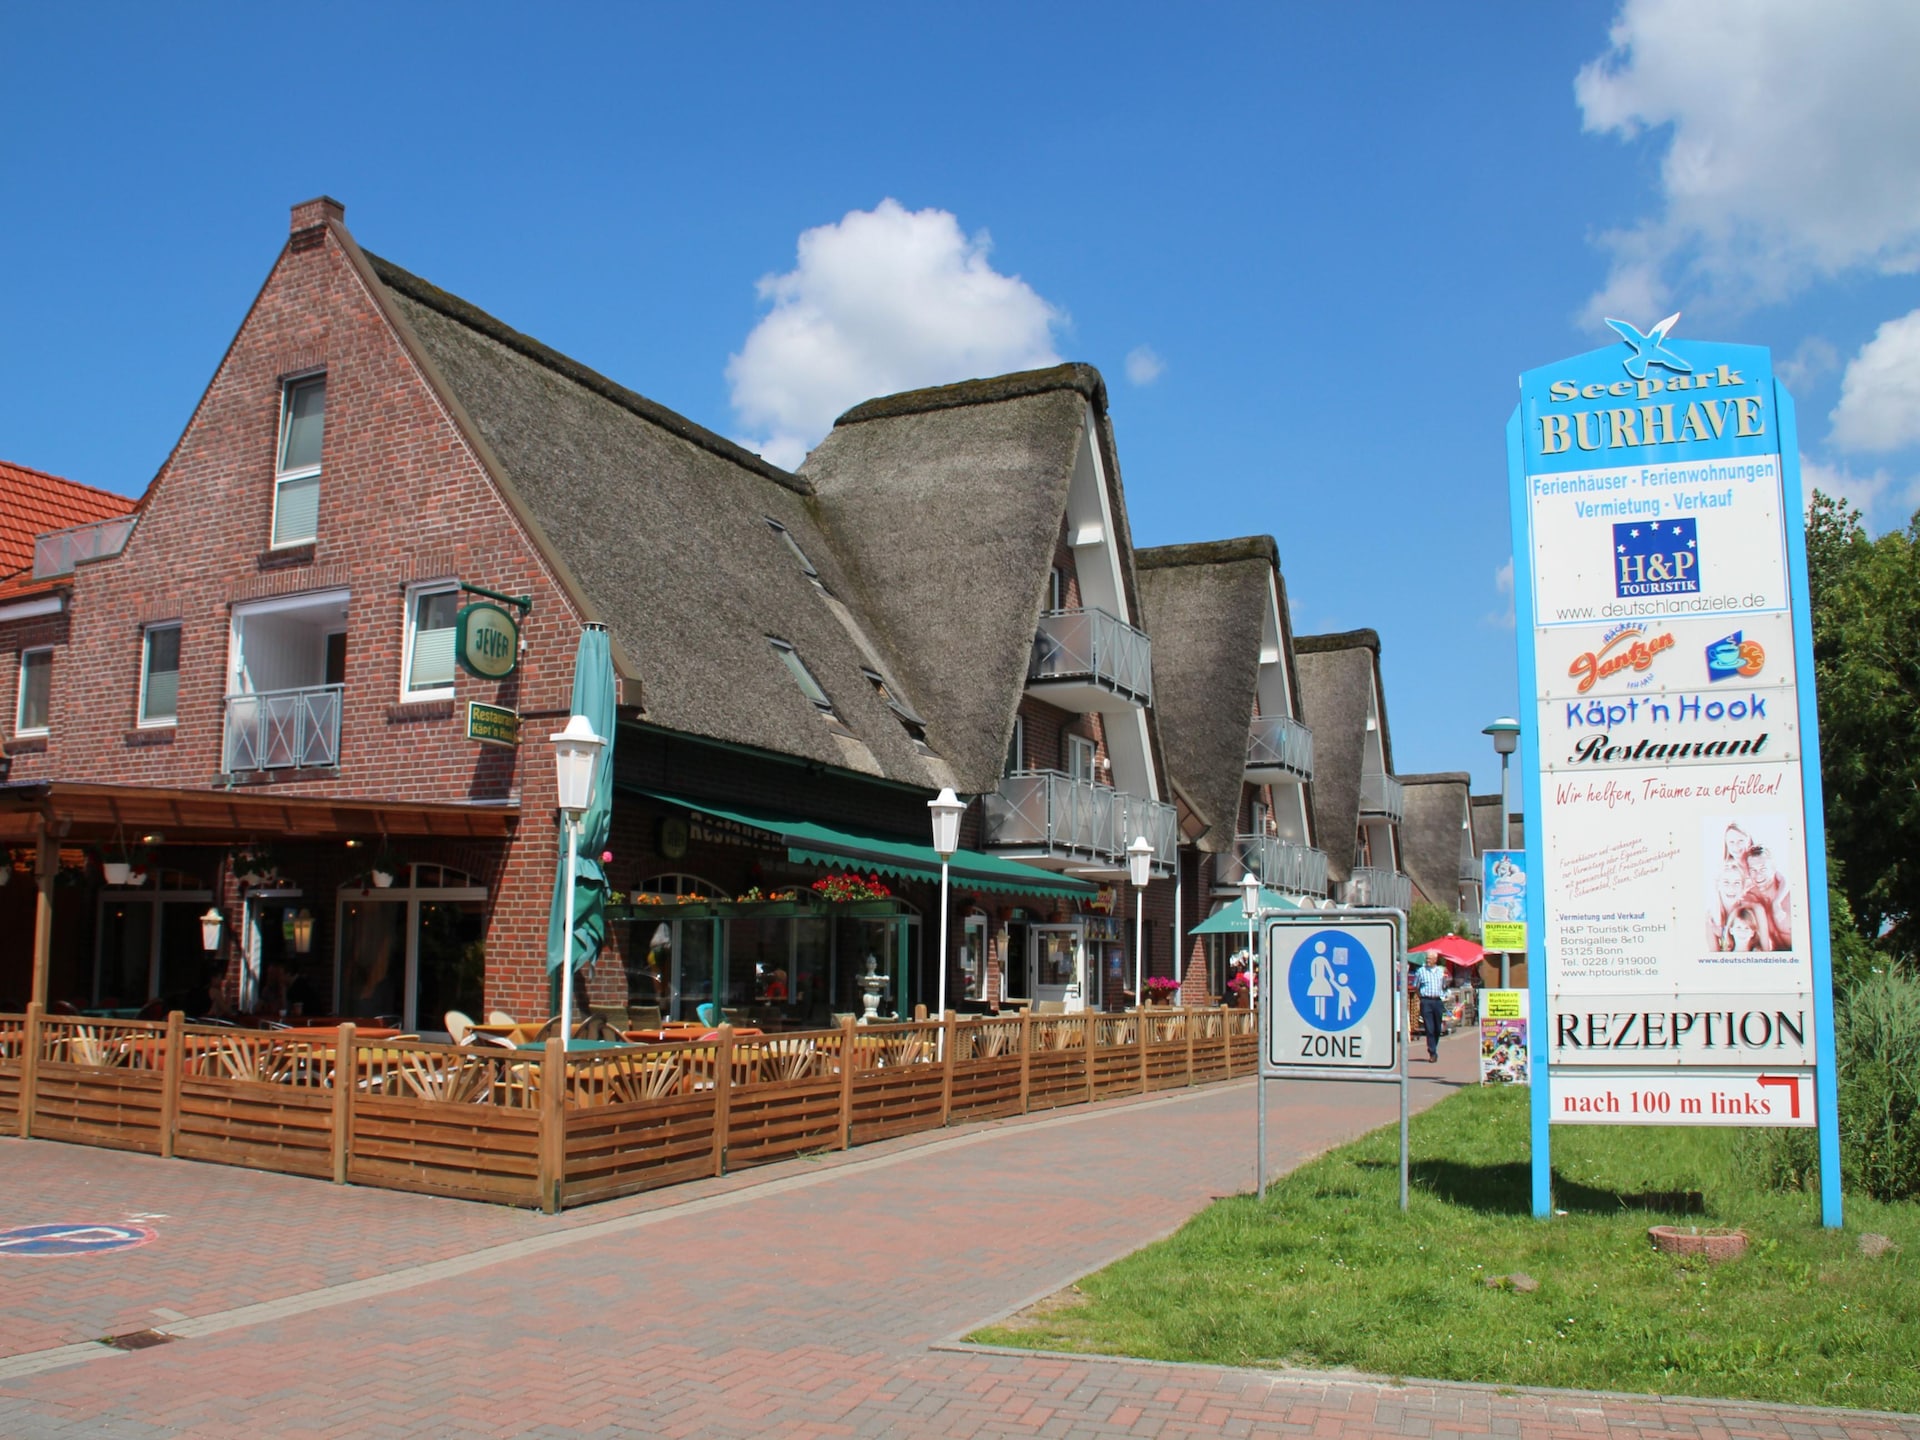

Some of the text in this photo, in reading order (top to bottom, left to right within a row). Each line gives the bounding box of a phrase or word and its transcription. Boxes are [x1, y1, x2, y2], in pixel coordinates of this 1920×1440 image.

[1550, 365, 1744, 402] Seepark
[1539, 396, 1766, 454] BURHAVE
[1533, 474, 1628, 496] Ferienhäuser
[1641, 461, 1774, 486] Ferienwohnungen
[1575, 494, 1660, 518] Vermietung
[1673, 489, 1733, 510] Verkauf
[1619, 551, 1695, 585] H&P
[1621, 580, 1697, 596] TOURISTIK
[1602, 593, 1766, 618] deutschlandziele.de
[476, 628, 509, 657] JEVER
[1568, 632, 1675, 693] Jantzen
[1679, 694, 1766, 721] Hook
[1567, 733, 1769, 764] Restaurant
[1556, 774, 1782, 808] Wir helfen, Träume zu erfüllen!
[1560, 913, 1600, 921] Vermietung
[1560, 924, 1666, 934] H&P Touristik GmbH
[1560, 936, 1618, 946] Borsigallee
[1560, 947, 1624, 956] 53125 Bonn
[1561, 958, 1578, 966] Tel.
[1582, 957, 1608, 966] 0228
[1617, 956, 1657, 965] 919000
[1561, 968, 1659, 978] www.hptouristik.de
[1556, 1011, 1806, 1049] REZEPTION
[1301, 1036, 1362, 1058] ZONE
[1564, 1090, 1771, 1116] nach 100 m links
